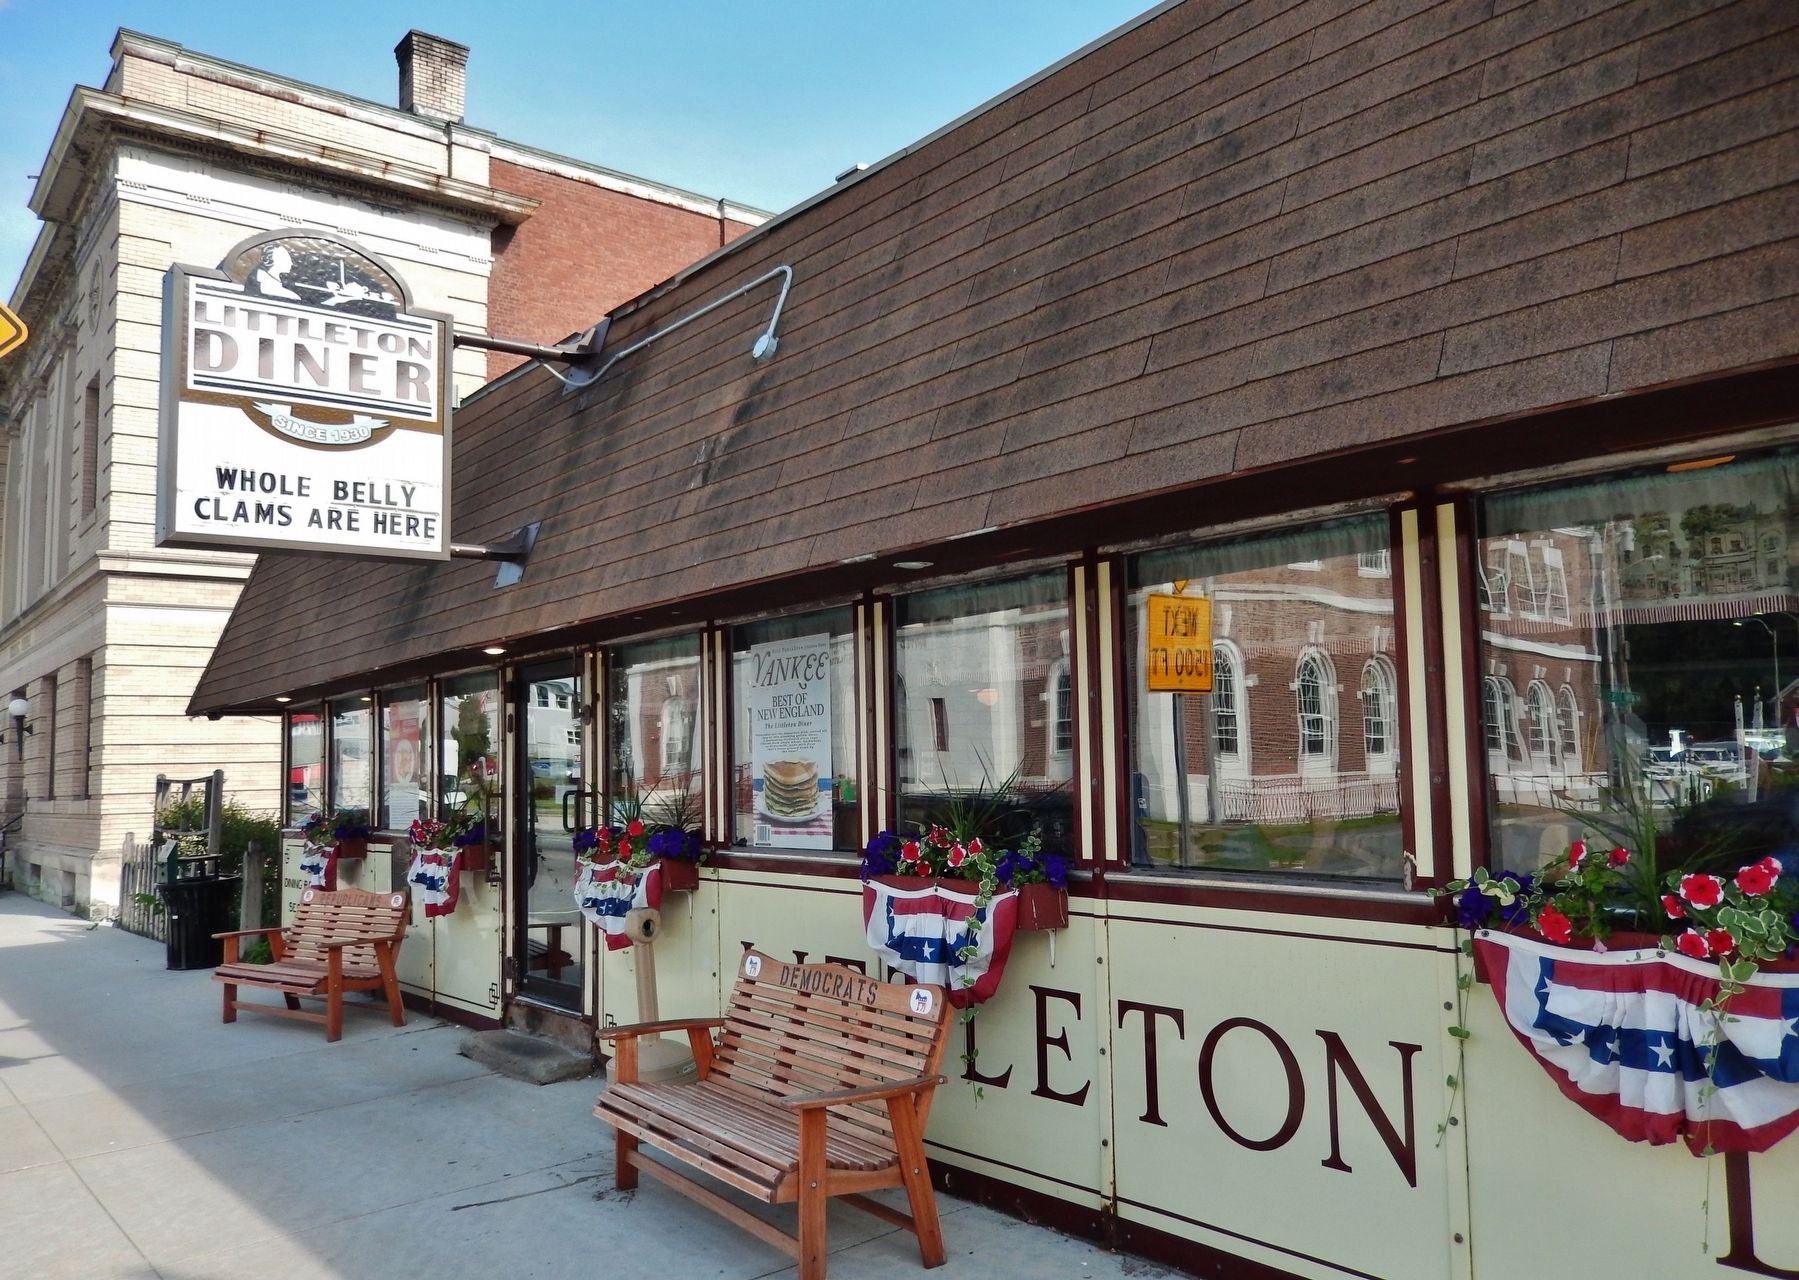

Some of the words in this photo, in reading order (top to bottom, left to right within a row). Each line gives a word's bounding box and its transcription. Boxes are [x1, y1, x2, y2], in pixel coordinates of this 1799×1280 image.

[195, 300, 432, 359] LITTLETON
[193, 328, 432, 403] DINER
[275, 415, 327, 441] SINCE
[331, 426, 369, 441] 1930
[215, 466, 311, 497] WHOLE
[333, 480, 416, 507] BELLY
[194, 497, 292, 527] CLAMS
[308, 508, 360, 532] ARE
[373, 513, 437, 539] HERE
[752, 651, 829, 688] YANKEE
[757, 708, 778, 721] NEW
[779, 703, 825, 719] ENGLAND
[772, 694, 794, 708] BEST
[795, 692, 808, 705] OF
[779, 965, 879, 1006] DEMOCRATS
